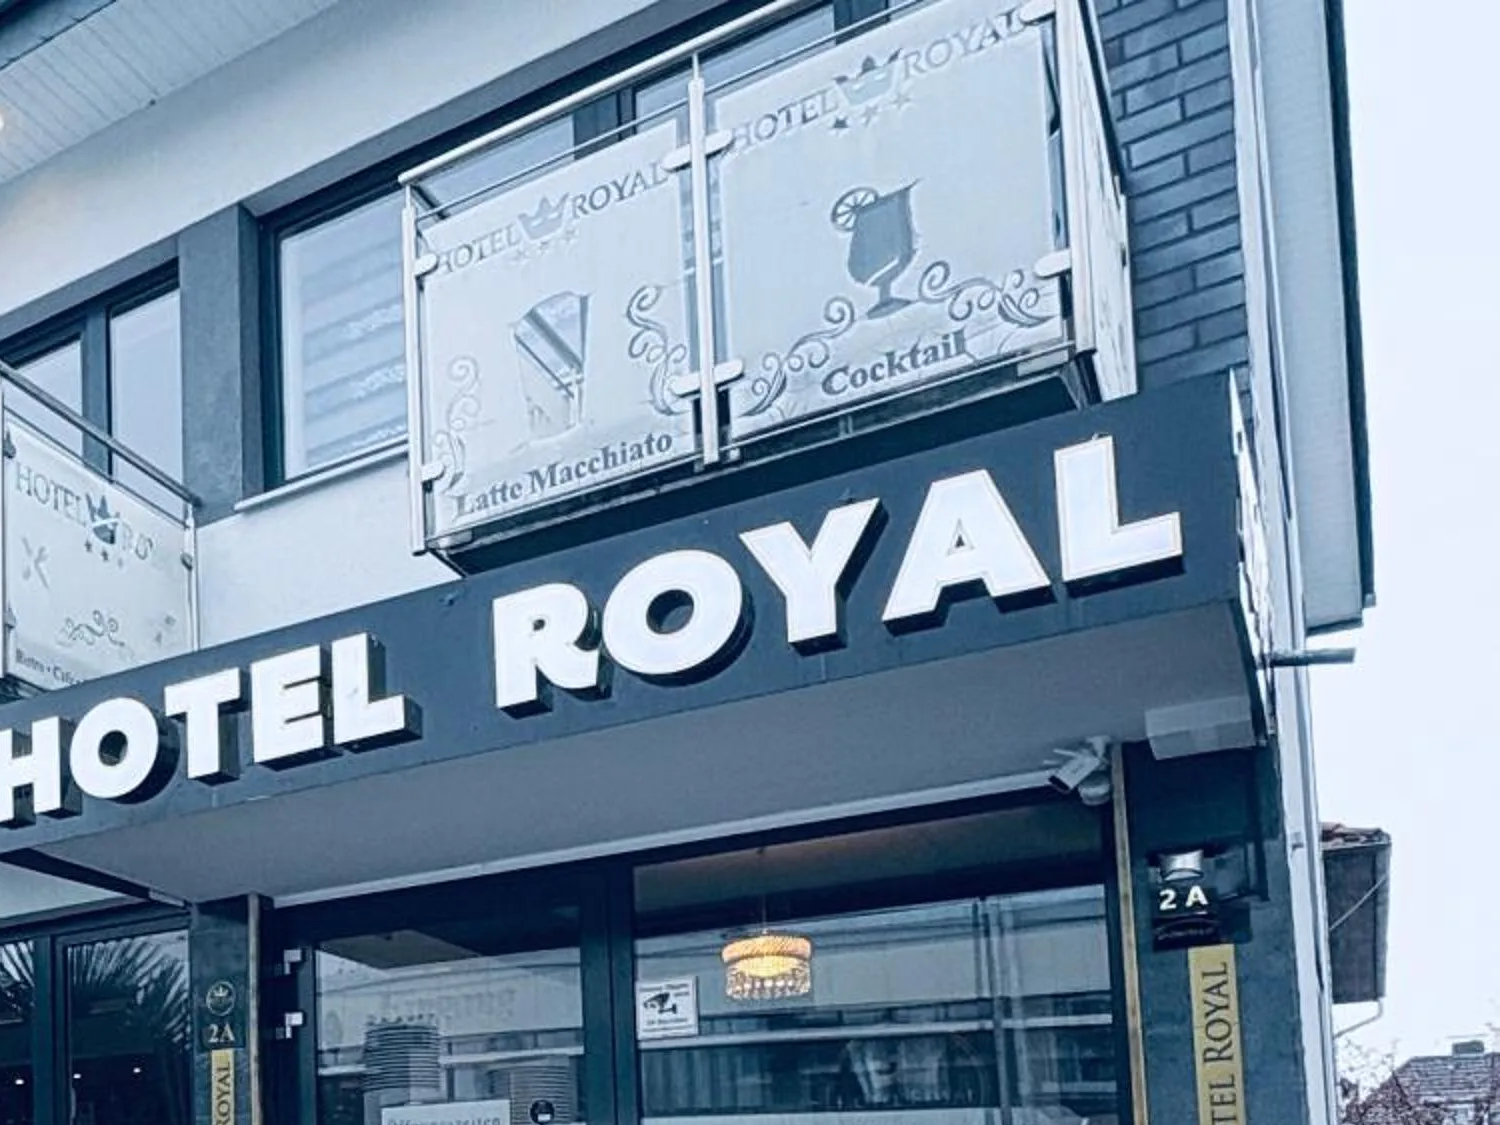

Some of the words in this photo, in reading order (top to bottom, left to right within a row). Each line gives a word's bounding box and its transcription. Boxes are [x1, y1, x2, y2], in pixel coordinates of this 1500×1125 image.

[727, 90, 839, 150] HOTEL
[901, 8, 1026, 80] ROYAL
[437, 226, 521, 273] HOTEL
[572, 162, 668, 221] ROYAL
[821, 329, 968, 396] Cocktail
[15, 461, 88, 528] HOTEL
[455, 481, 523, 518] Latte
[529, 430, 673, 494] Macchiato
[493, 435, 1184, 714] ROYAL
[207, 1023, 236, 1044] 2A
[1201, 961, 1234, 1064] ROYAL
